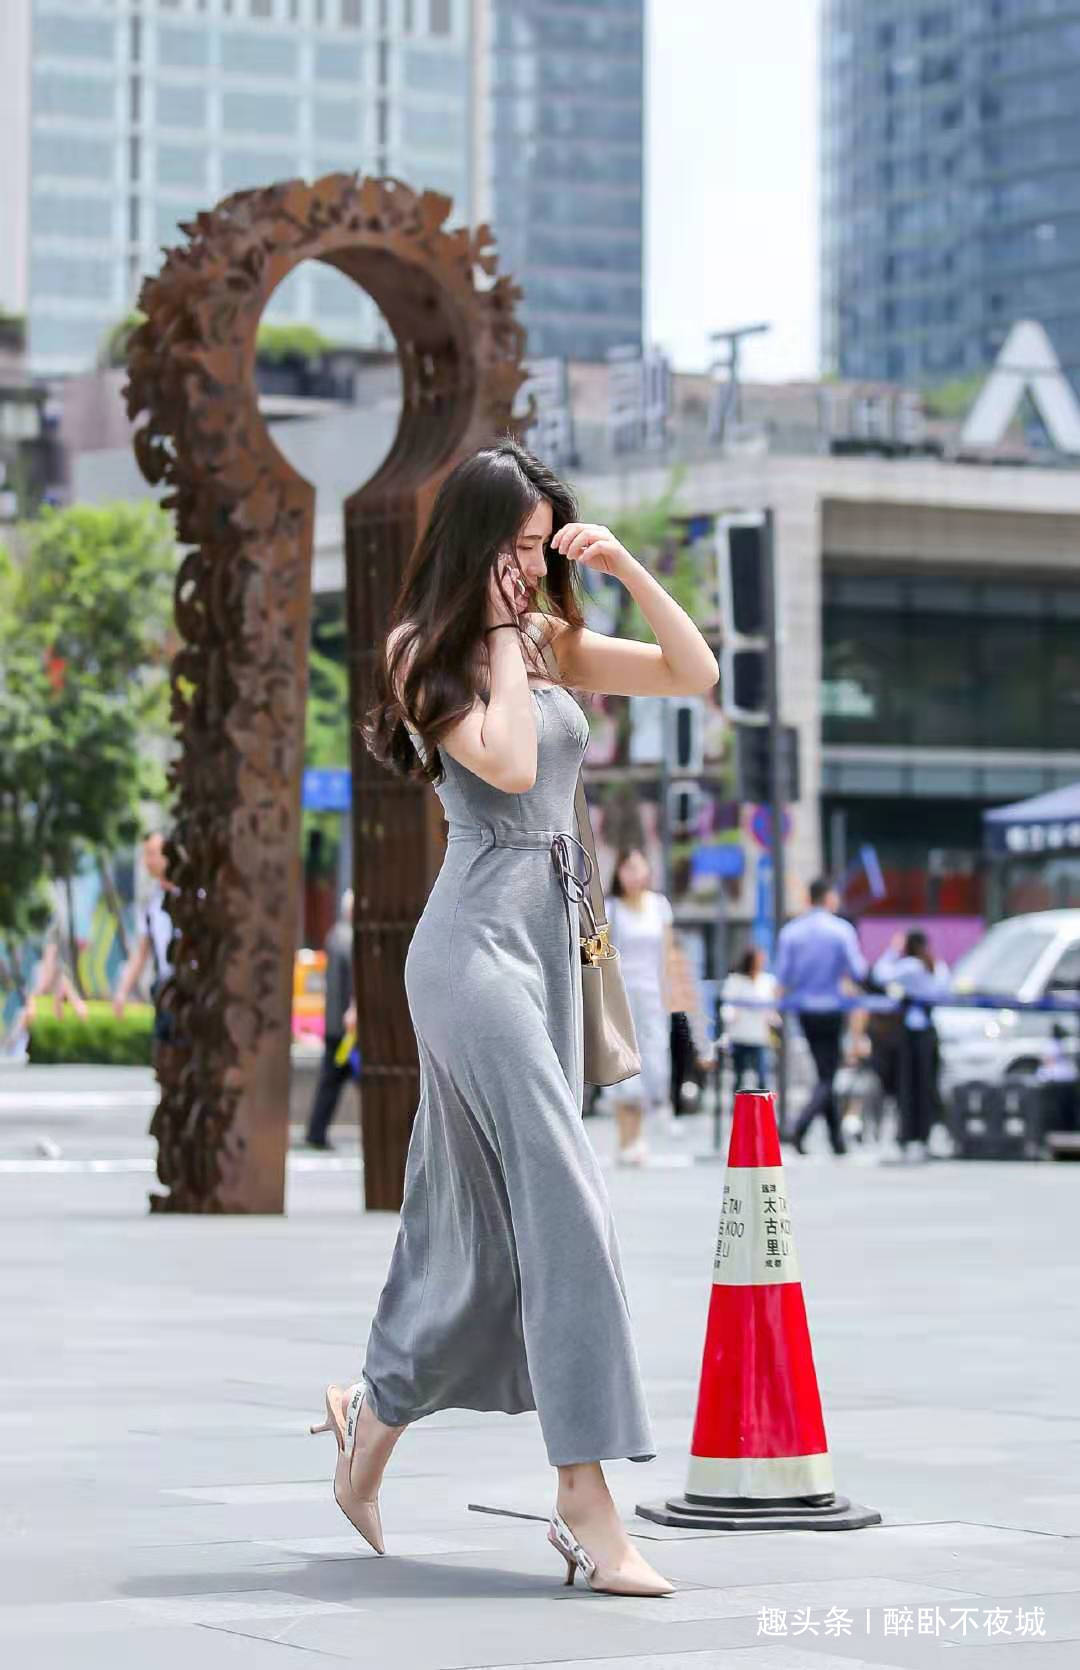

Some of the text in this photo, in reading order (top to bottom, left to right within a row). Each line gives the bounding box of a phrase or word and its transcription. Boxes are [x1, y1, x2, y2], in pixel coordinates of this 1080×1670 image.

[729, 1198, 742, 1215] TAI
[764, 1197, 781, 1256] 太古里
